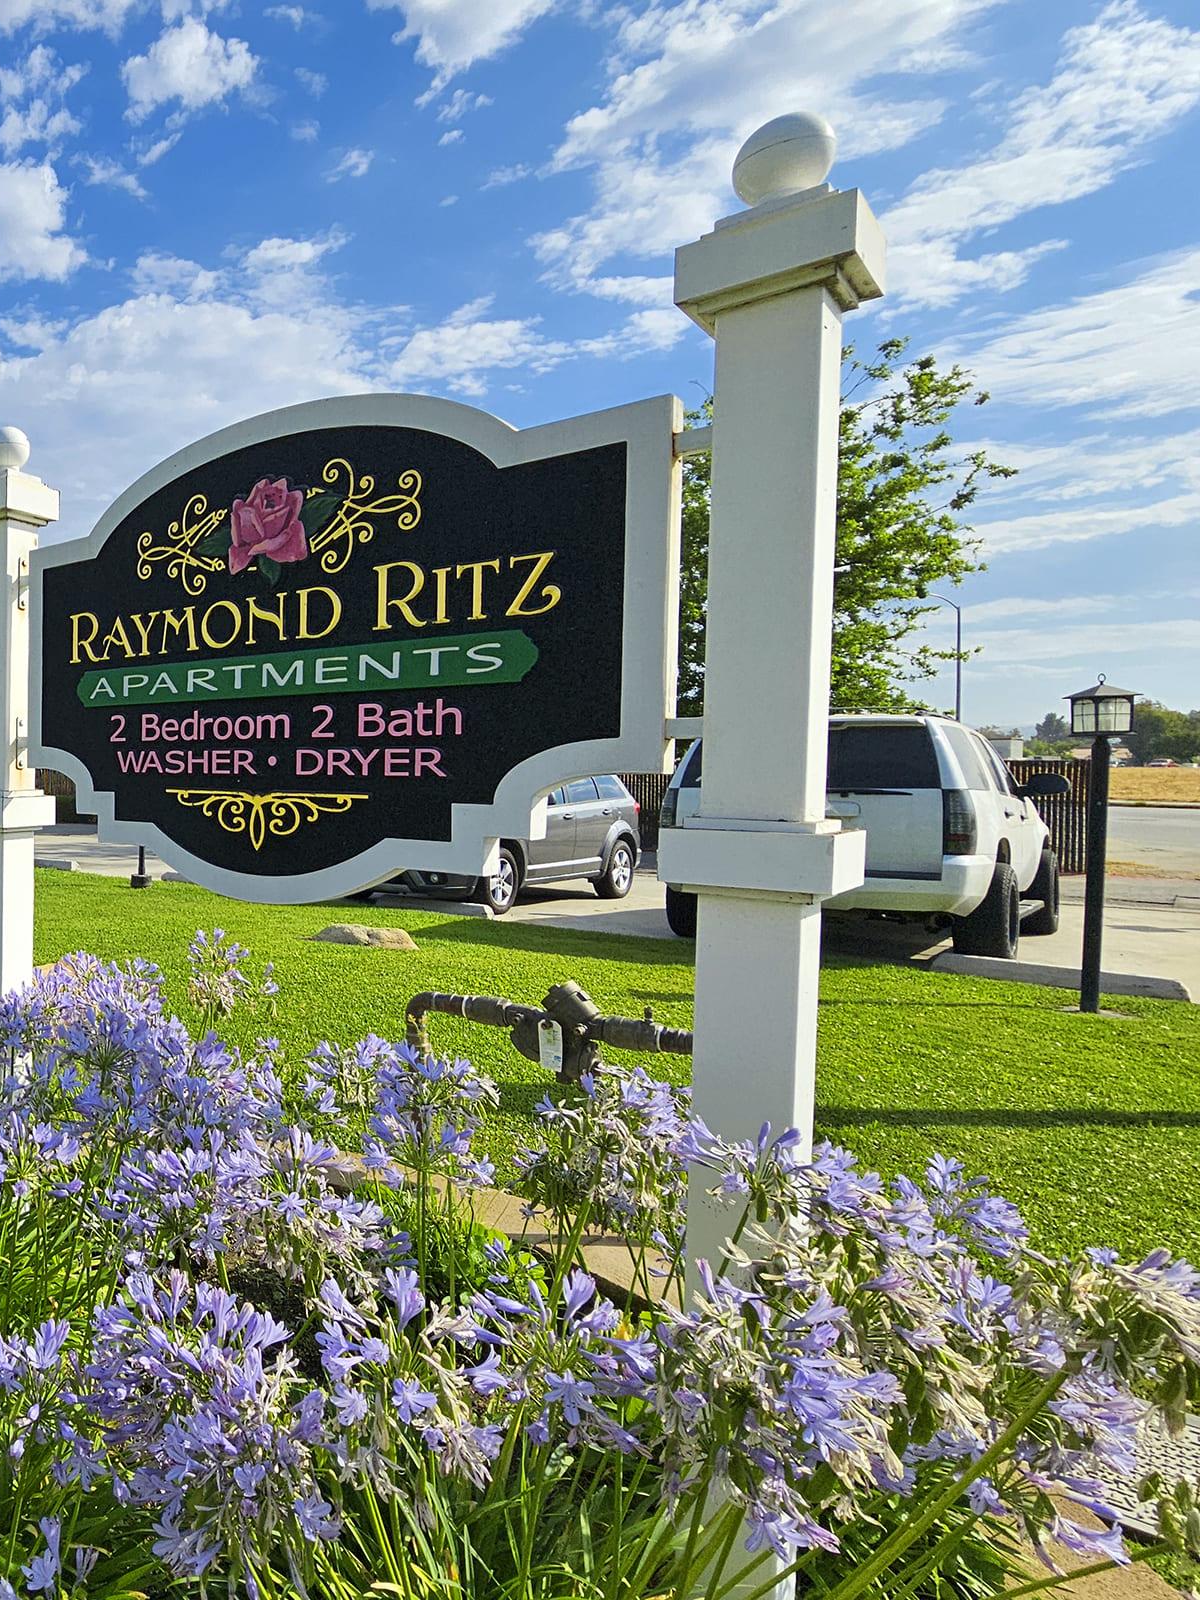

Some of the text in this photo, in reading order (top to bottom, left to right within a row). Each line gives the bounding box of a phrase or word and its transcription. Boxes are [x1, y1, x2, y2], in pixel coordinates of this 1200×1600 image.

[69, 551, 563, 664] RAYMOND RITZ
[89, 641, 505, 700] APARTMENTS
[110, 699, 463, 742] 2 Bedroom 2 Bath
[117, 747, 448, 777] WASHER DRYER
